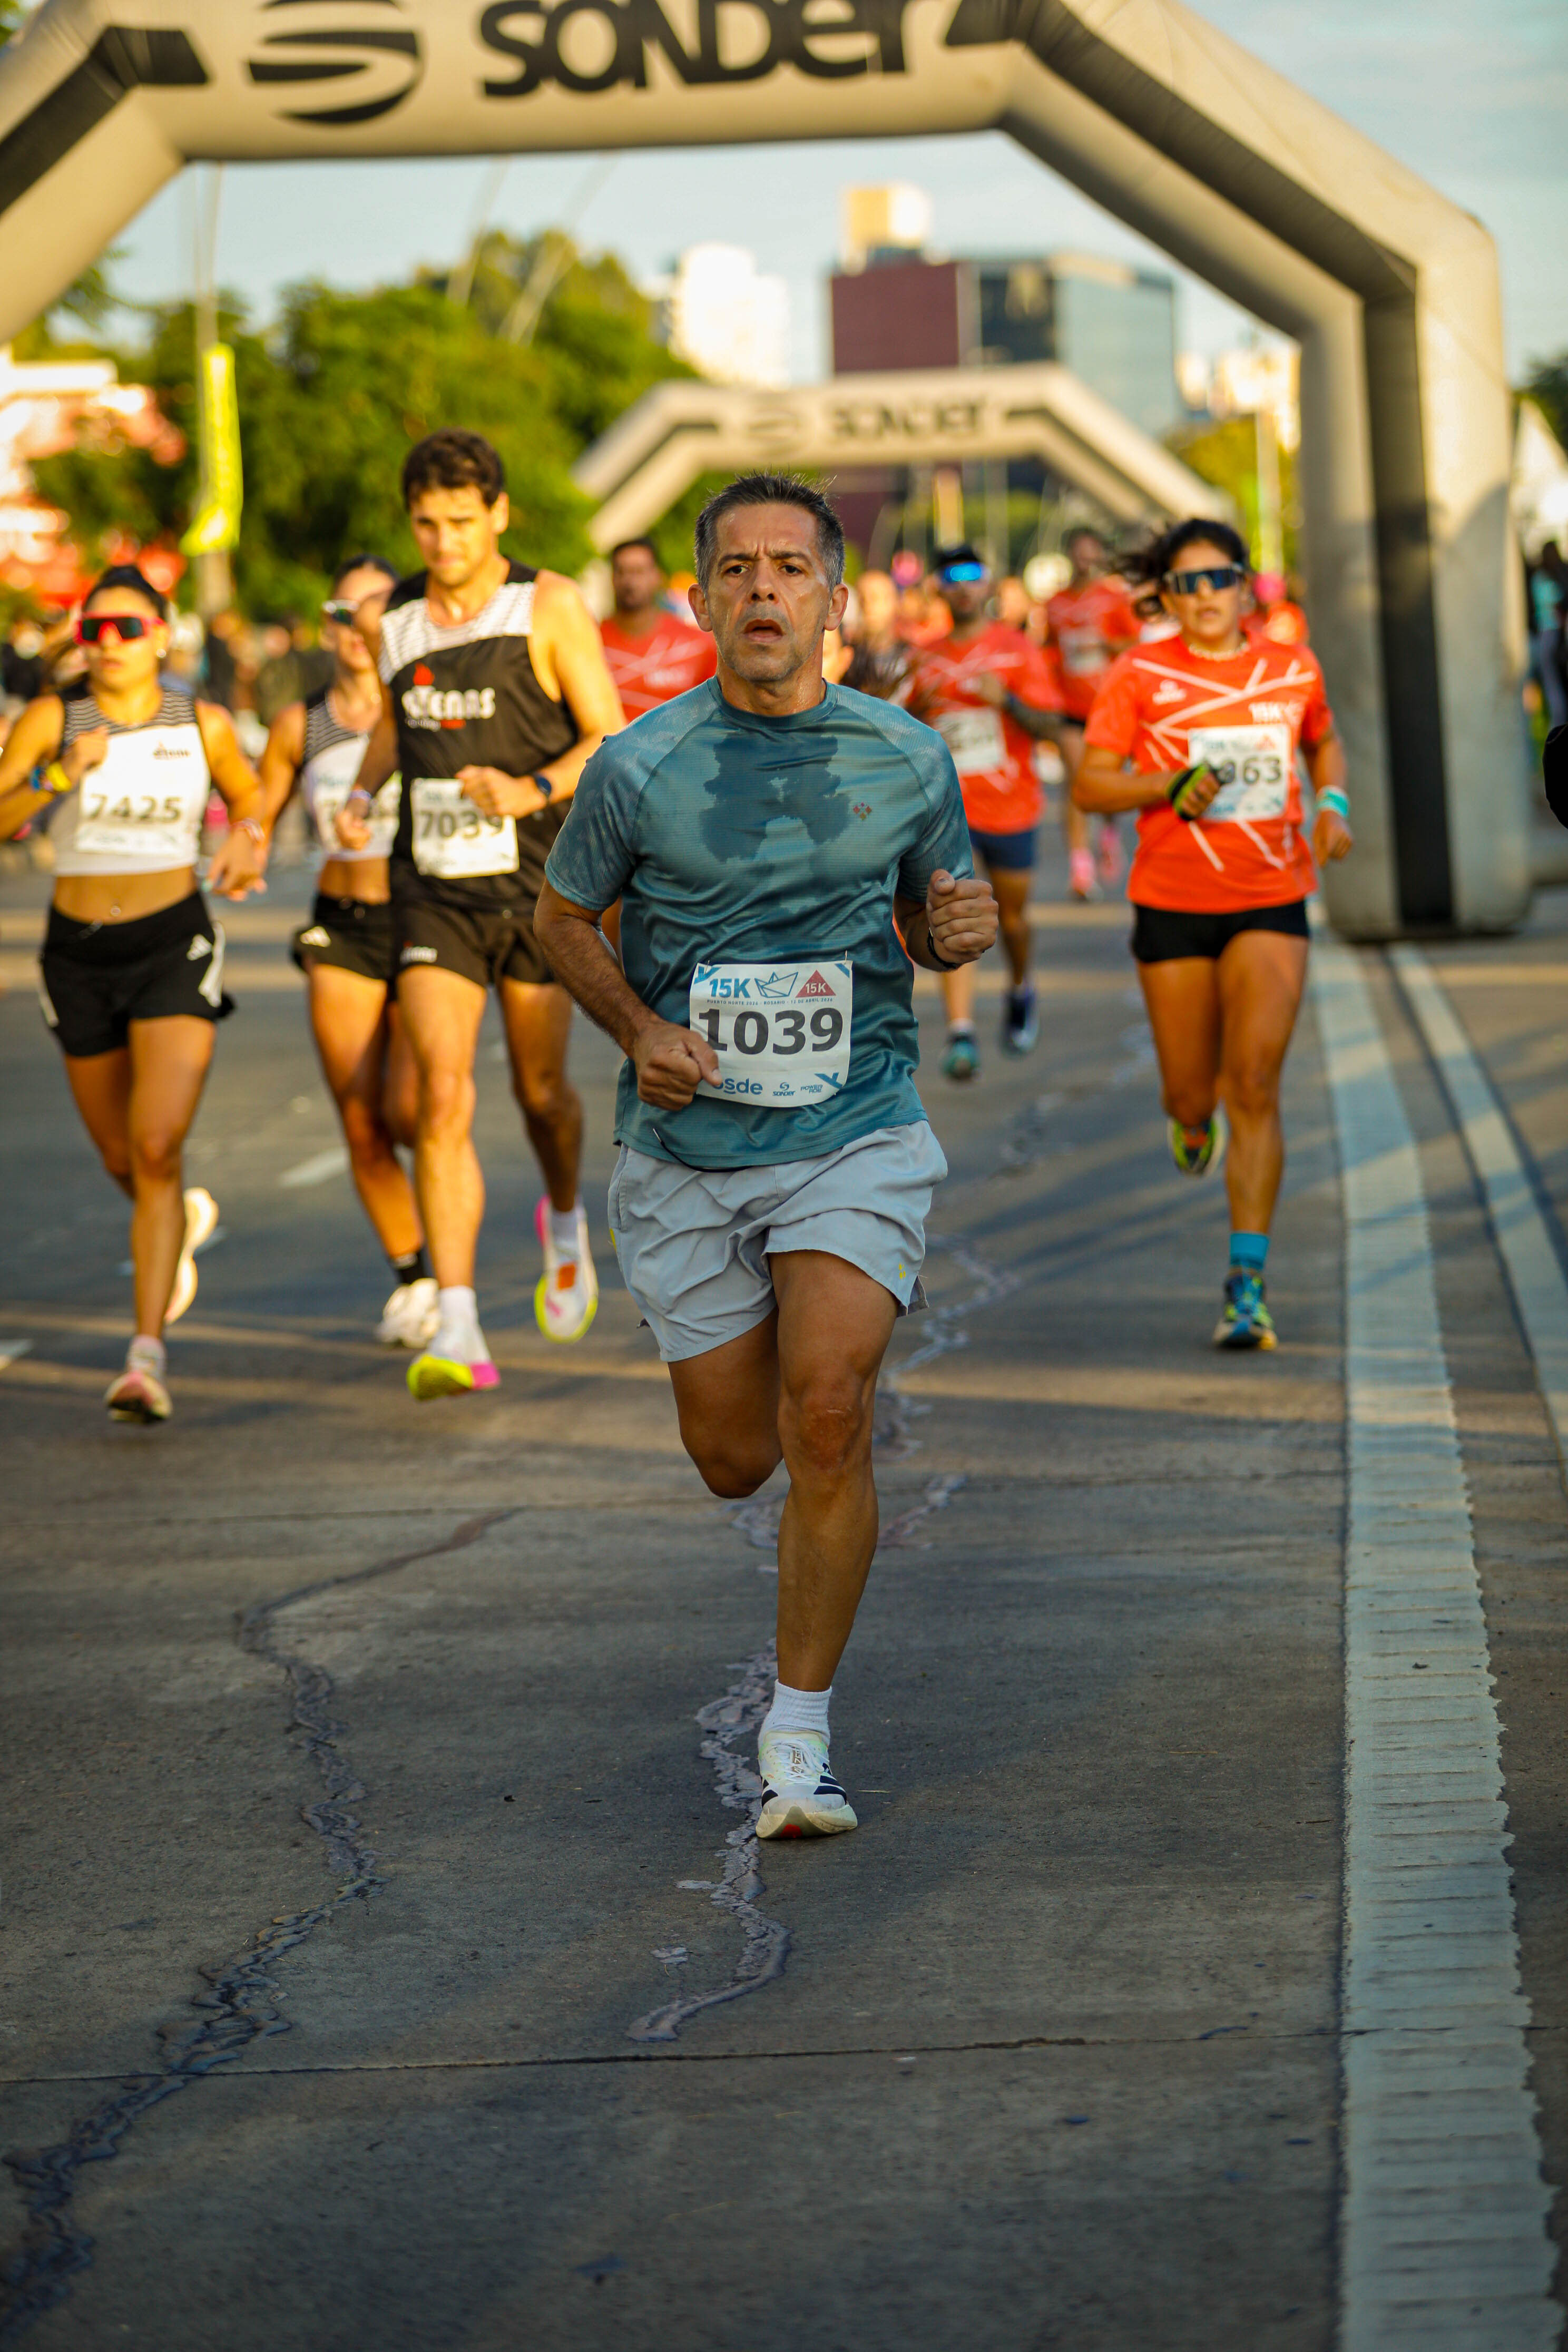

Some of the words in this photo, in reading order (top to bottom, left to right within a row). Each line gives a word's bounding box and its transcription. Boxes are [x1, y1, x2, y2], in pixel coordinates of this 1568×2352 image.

[90, 793, 183, 824] 7425
[709, 977, 751, 998] 15K
[805, 982, 827, 994] 15K
[699, 1007, 843, 1055] 1039
